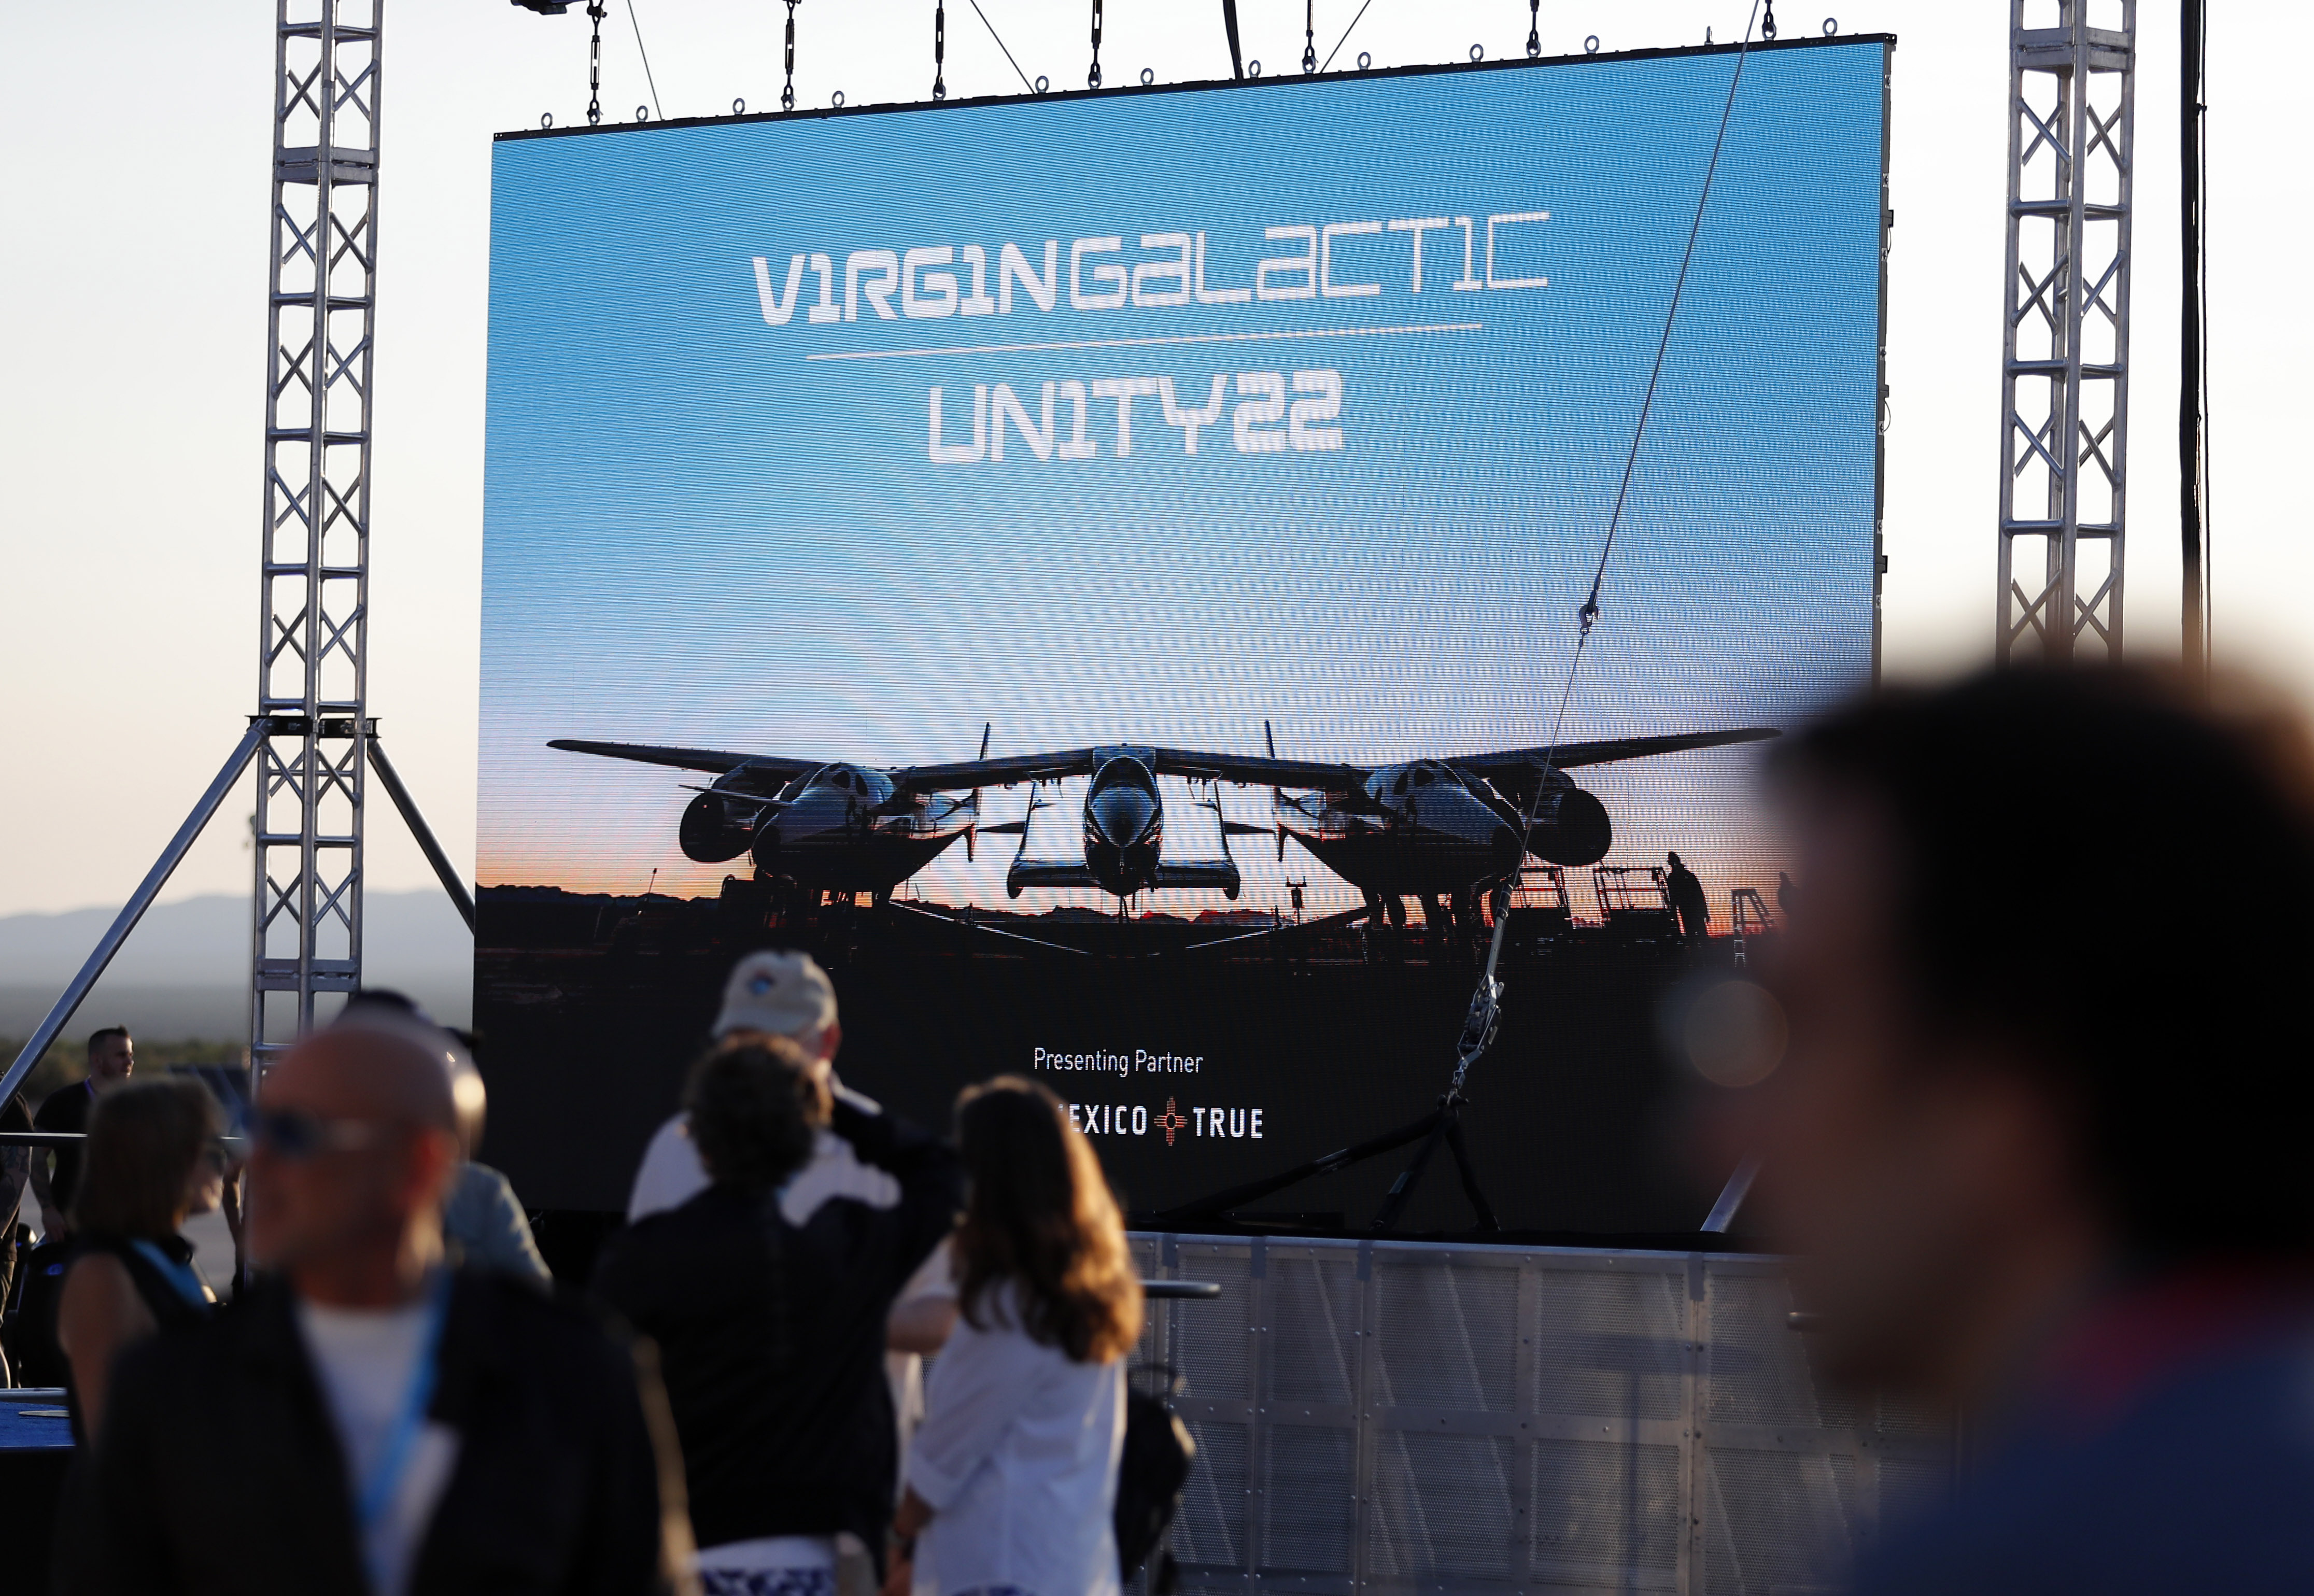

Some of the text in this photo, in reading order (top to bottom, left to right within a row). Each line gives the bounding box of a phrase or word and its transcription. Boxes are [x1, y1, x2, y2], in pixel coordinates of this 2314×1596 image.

[1034, 1047, 1204, 1078] Presenting Partner
[1057, 1103, 1263, 1138] EXICO TRUE
